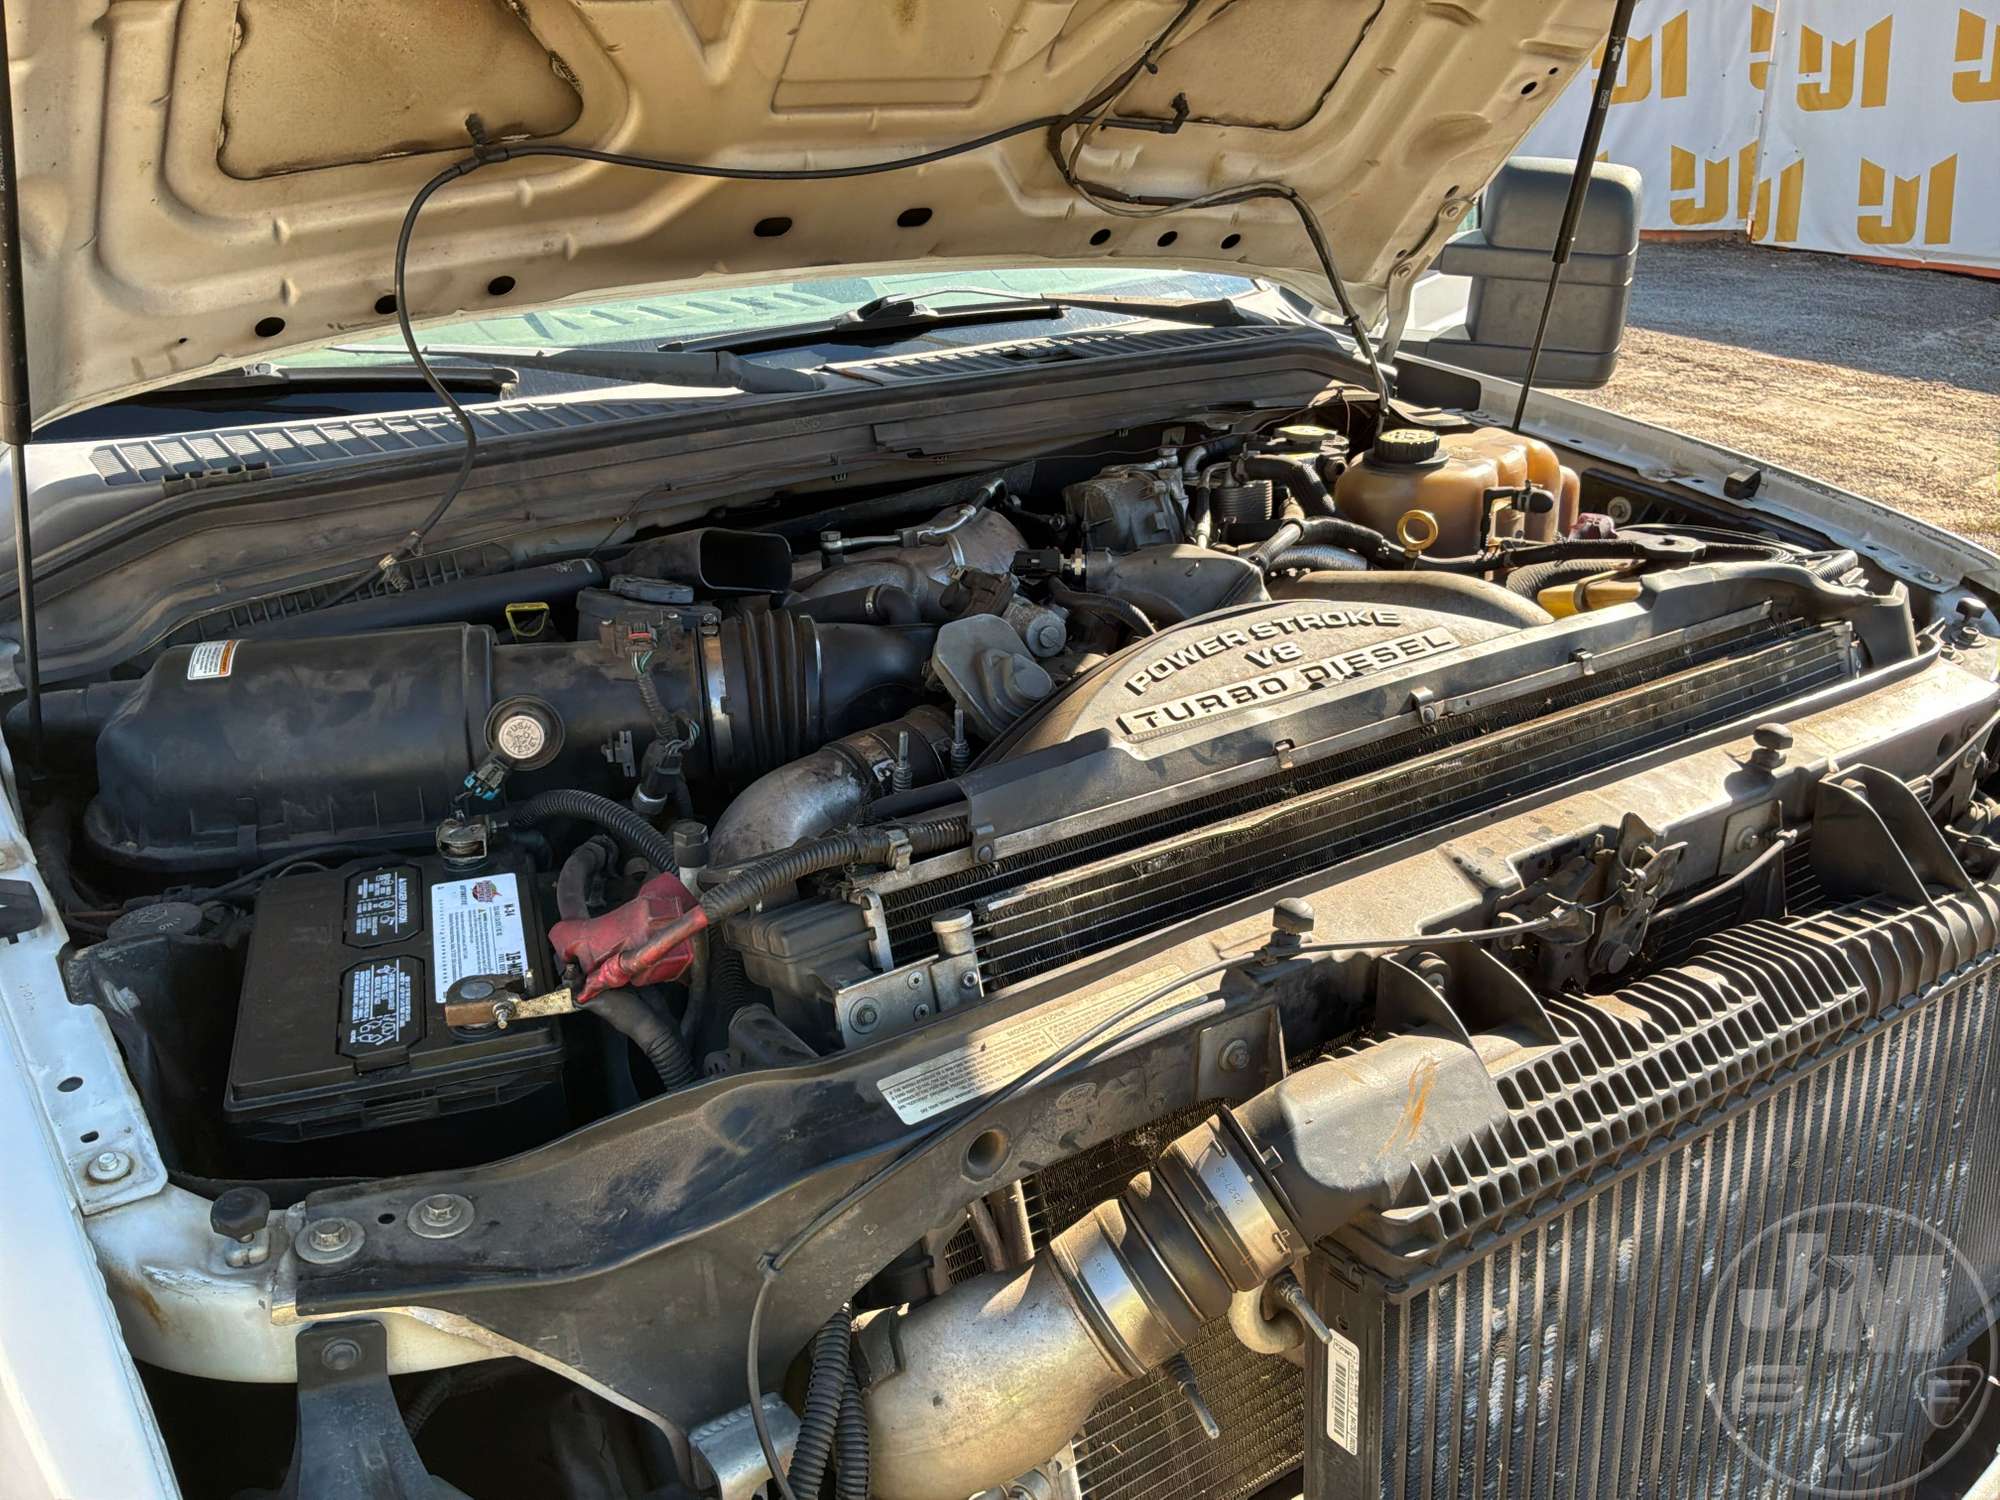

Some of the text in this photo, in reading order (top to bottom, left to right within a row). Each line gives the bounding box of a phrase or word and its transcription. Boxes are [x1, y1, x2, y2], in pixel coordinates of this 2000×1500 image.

[1125, 610, 1401, 696] POWER STROKE
[1245, 641, 1303, 669] V8
[1133, 634, 1451, 729] TURBO DIESEL
[506, 722, 532, 737] PUSH
[510, 736, 539, 754] RESET
